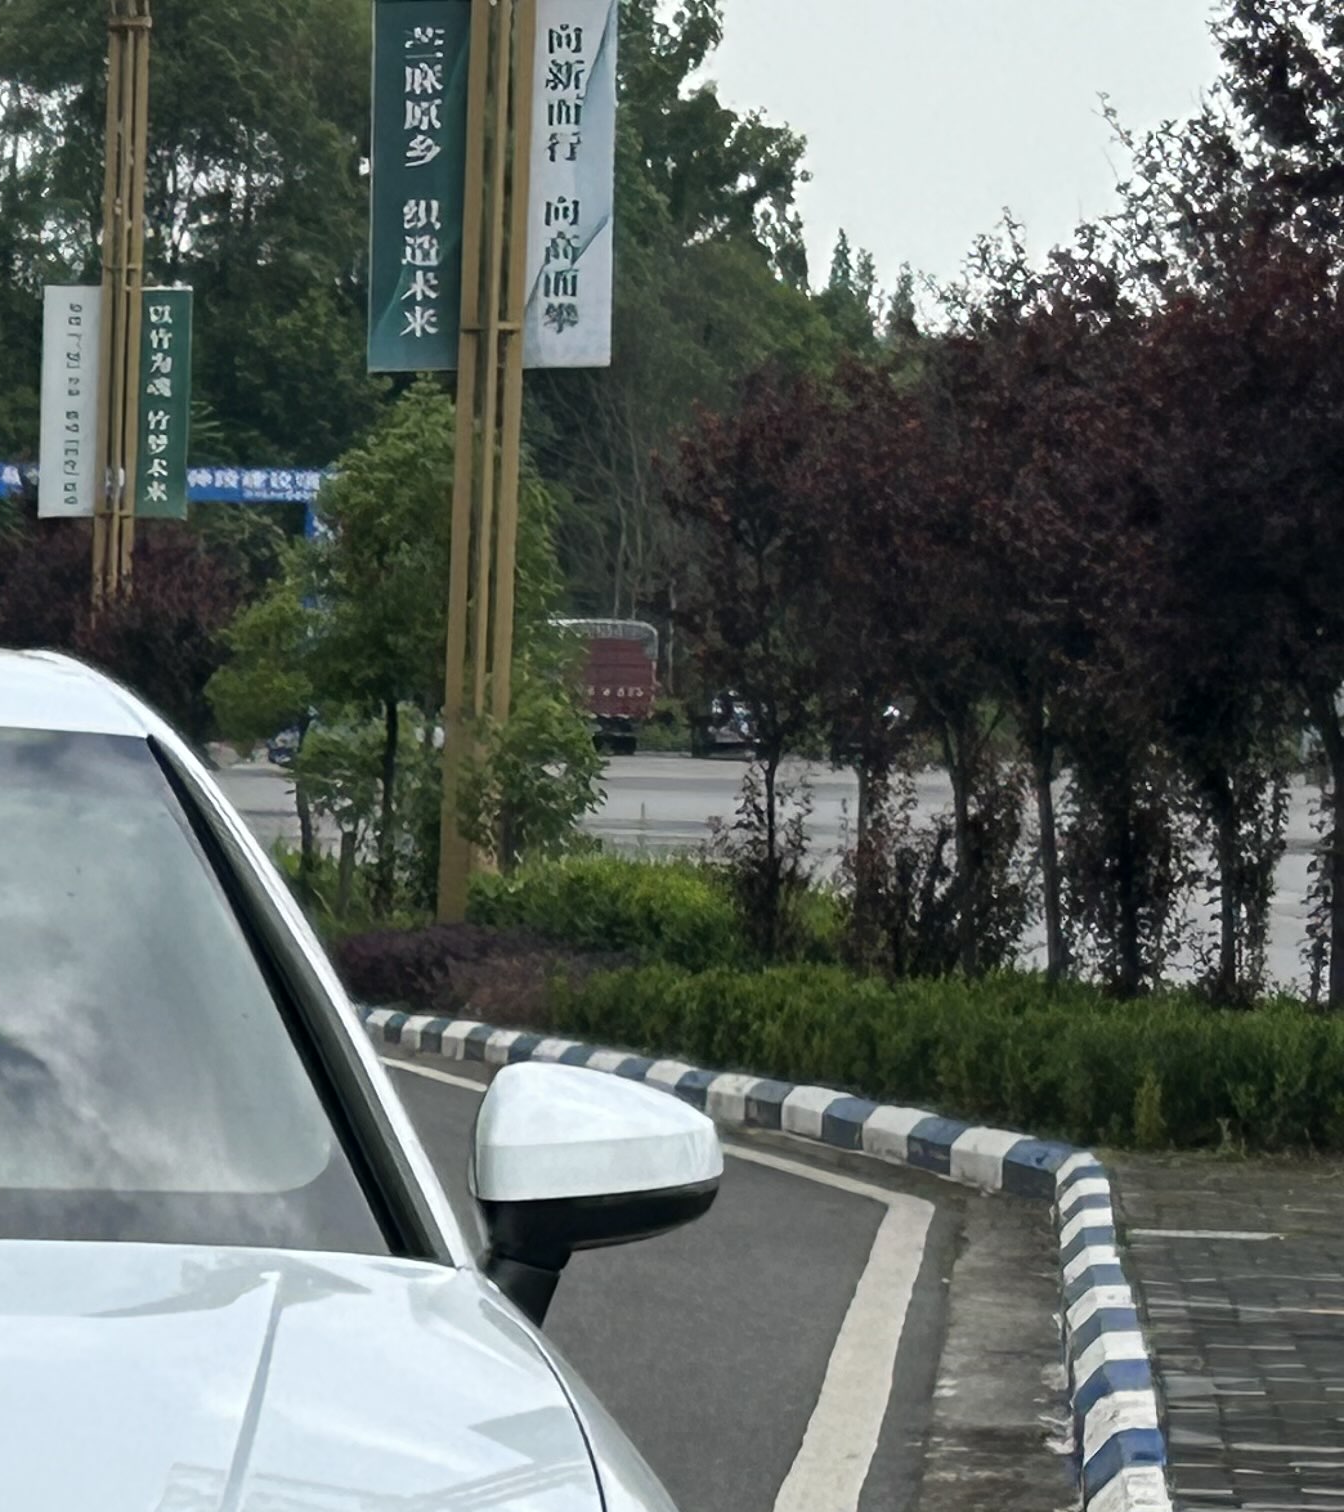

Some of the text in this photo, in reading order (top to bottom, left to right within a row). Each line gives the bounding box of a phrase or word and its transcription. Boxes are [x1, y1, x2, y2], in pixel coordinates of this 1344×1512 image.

[545, 23, 585, 162] 向新而行
[399, 199, 442, 338] 织造未来
